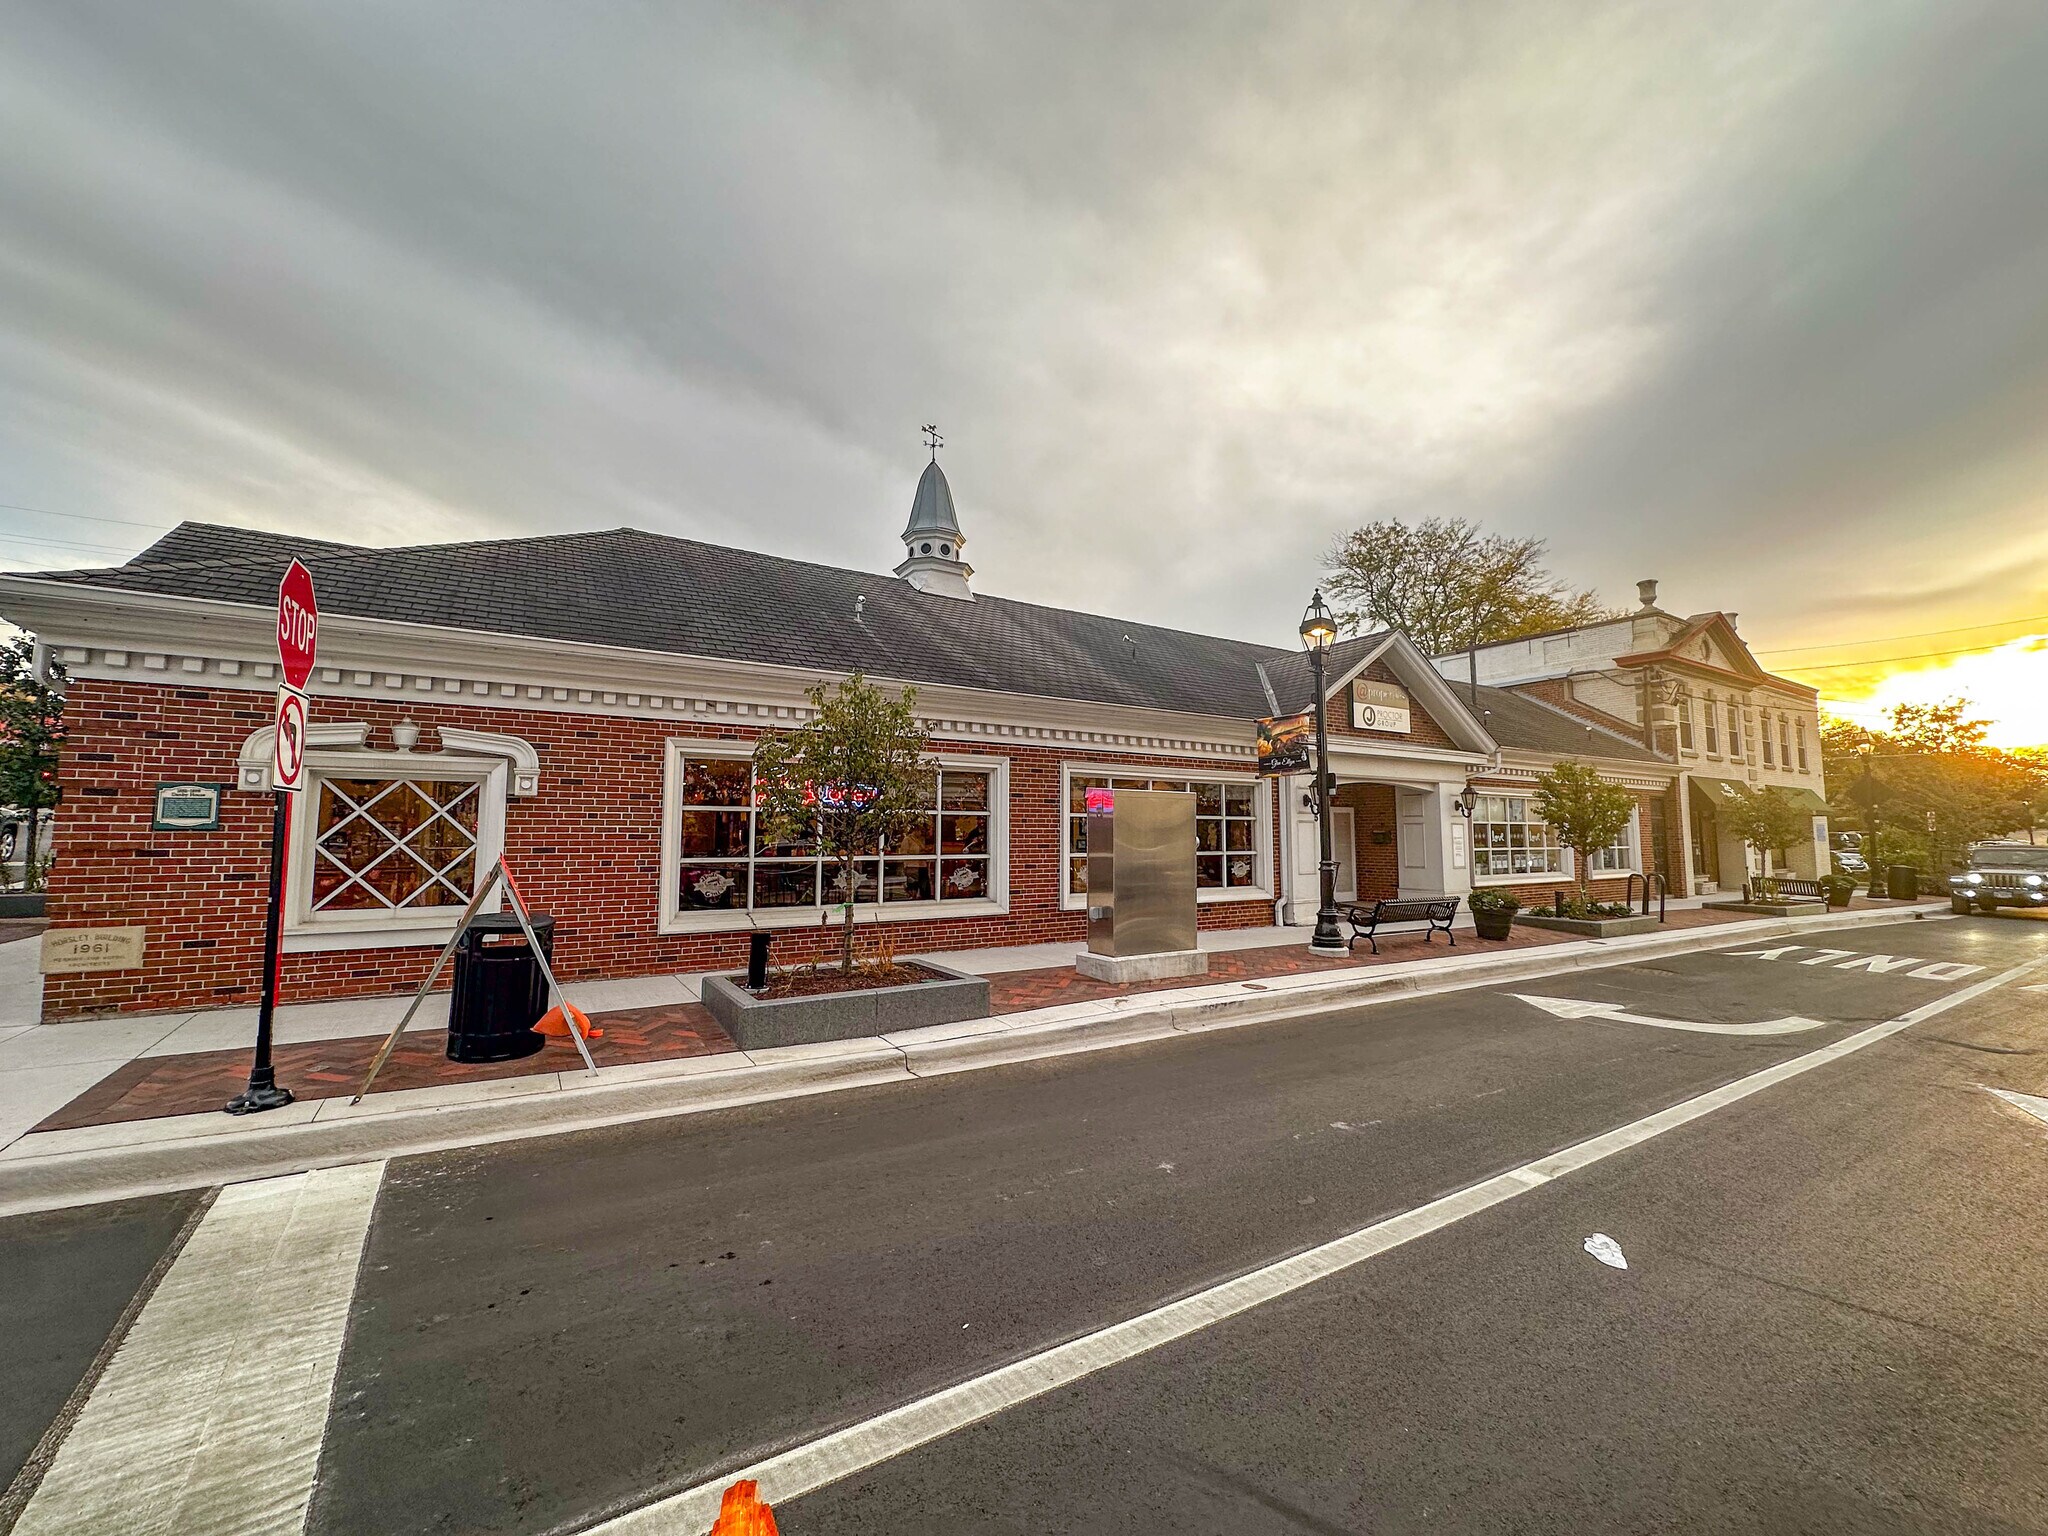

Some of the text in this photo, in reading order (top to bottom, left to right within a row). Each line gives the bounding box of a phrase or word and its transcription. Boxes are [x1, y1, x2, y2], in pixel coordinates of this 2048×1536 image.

[281, 595, 315, 655] STOP
[1376, 710, 1403, 720] PROCTOR
[1377, 720, 1397, 728] GROUP
[73, 943, 109, 954] 1961
[1723, 945, 1987, 981] ONLY
